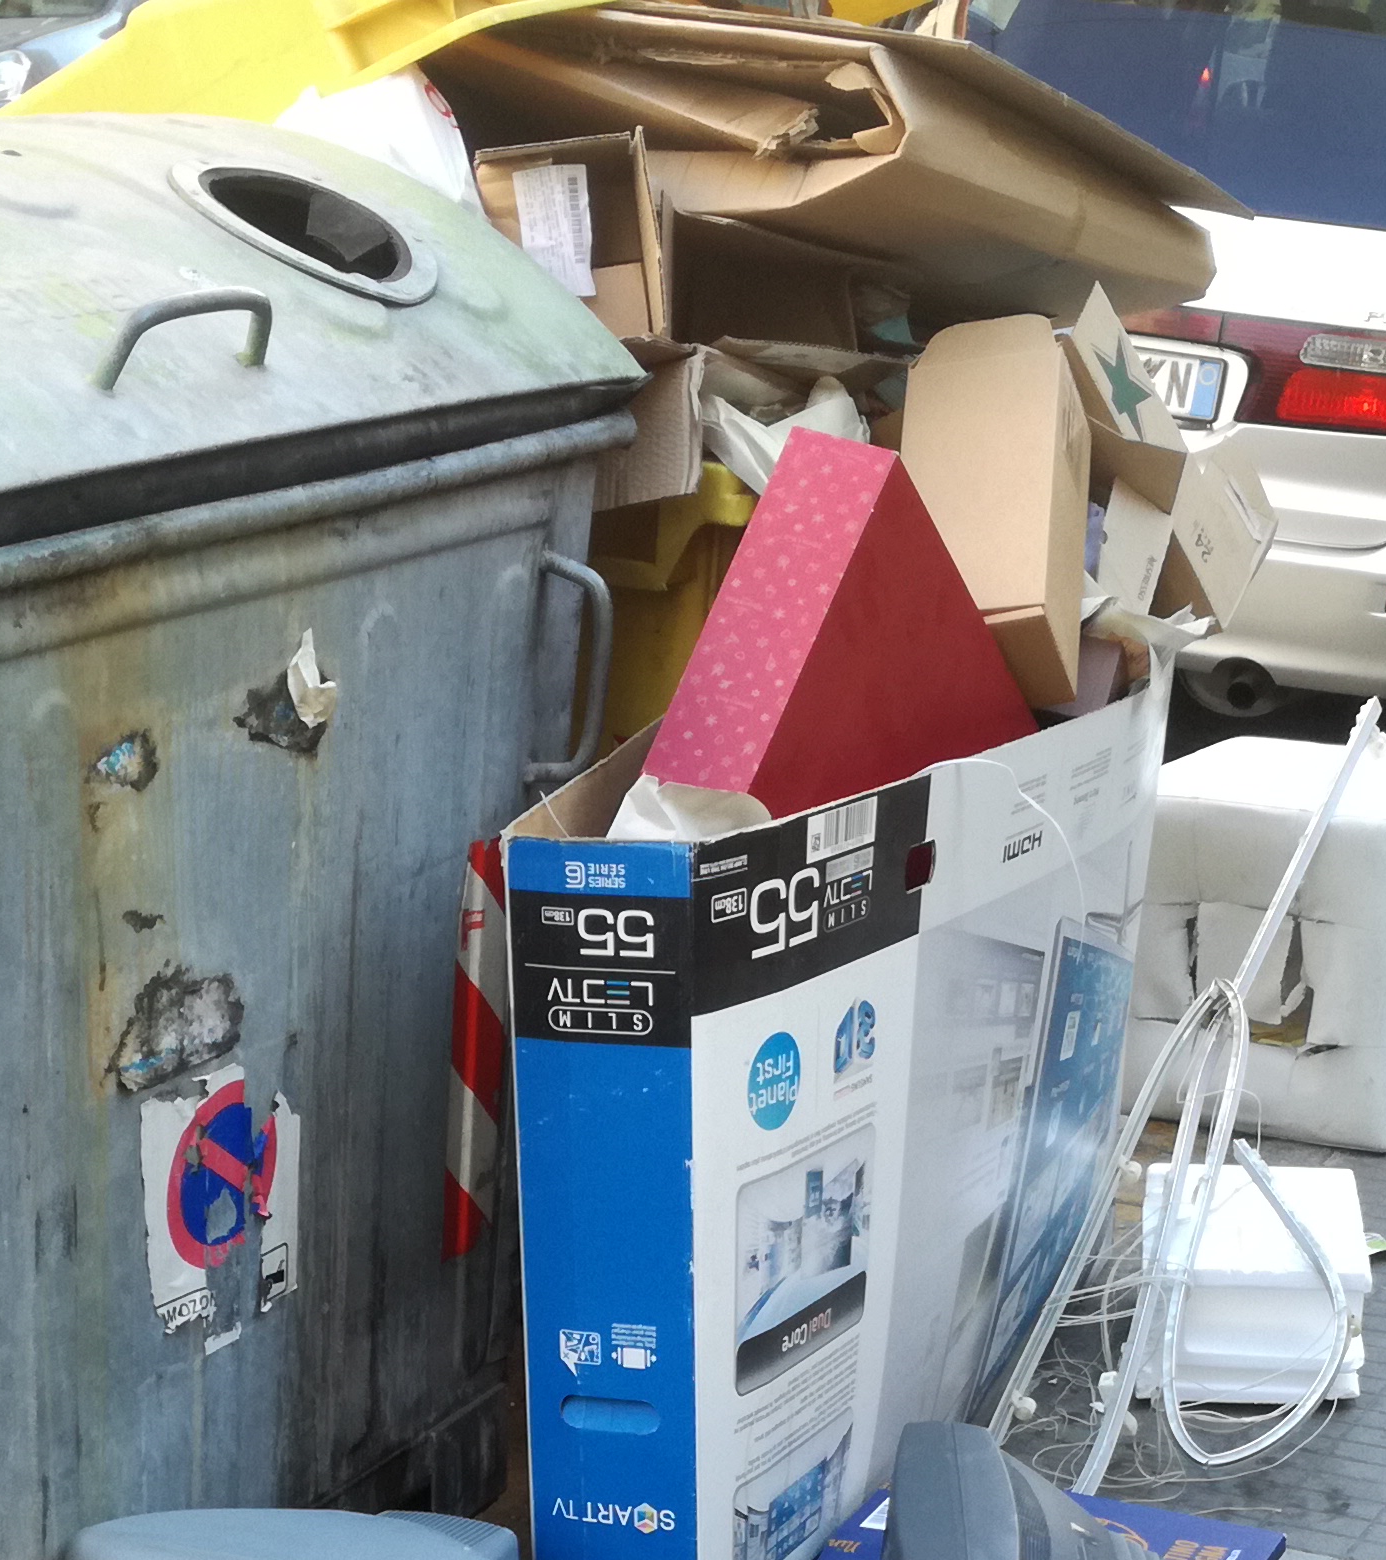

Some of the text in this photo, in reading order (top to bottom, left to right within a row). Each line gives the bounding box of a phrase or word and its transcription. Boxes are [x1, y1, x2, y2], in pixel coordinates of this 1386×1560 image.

[1003, 831, 1043, 864] HDMI
[588, 875, 626, 888] SERIES
[715, 866, 820, 959] 55 138cm
[827, 900, 867, 928] SLIM
[577, 908, 655, 958] 55
[559, 1010, 643, 1031] SLIM
[756, 1050, 794, 1086] First
[748, 1076, 799, 1115] Planet
[781, 1308, 832, 1352] Dual Core
[551, 1498, 579, 1521] TV
